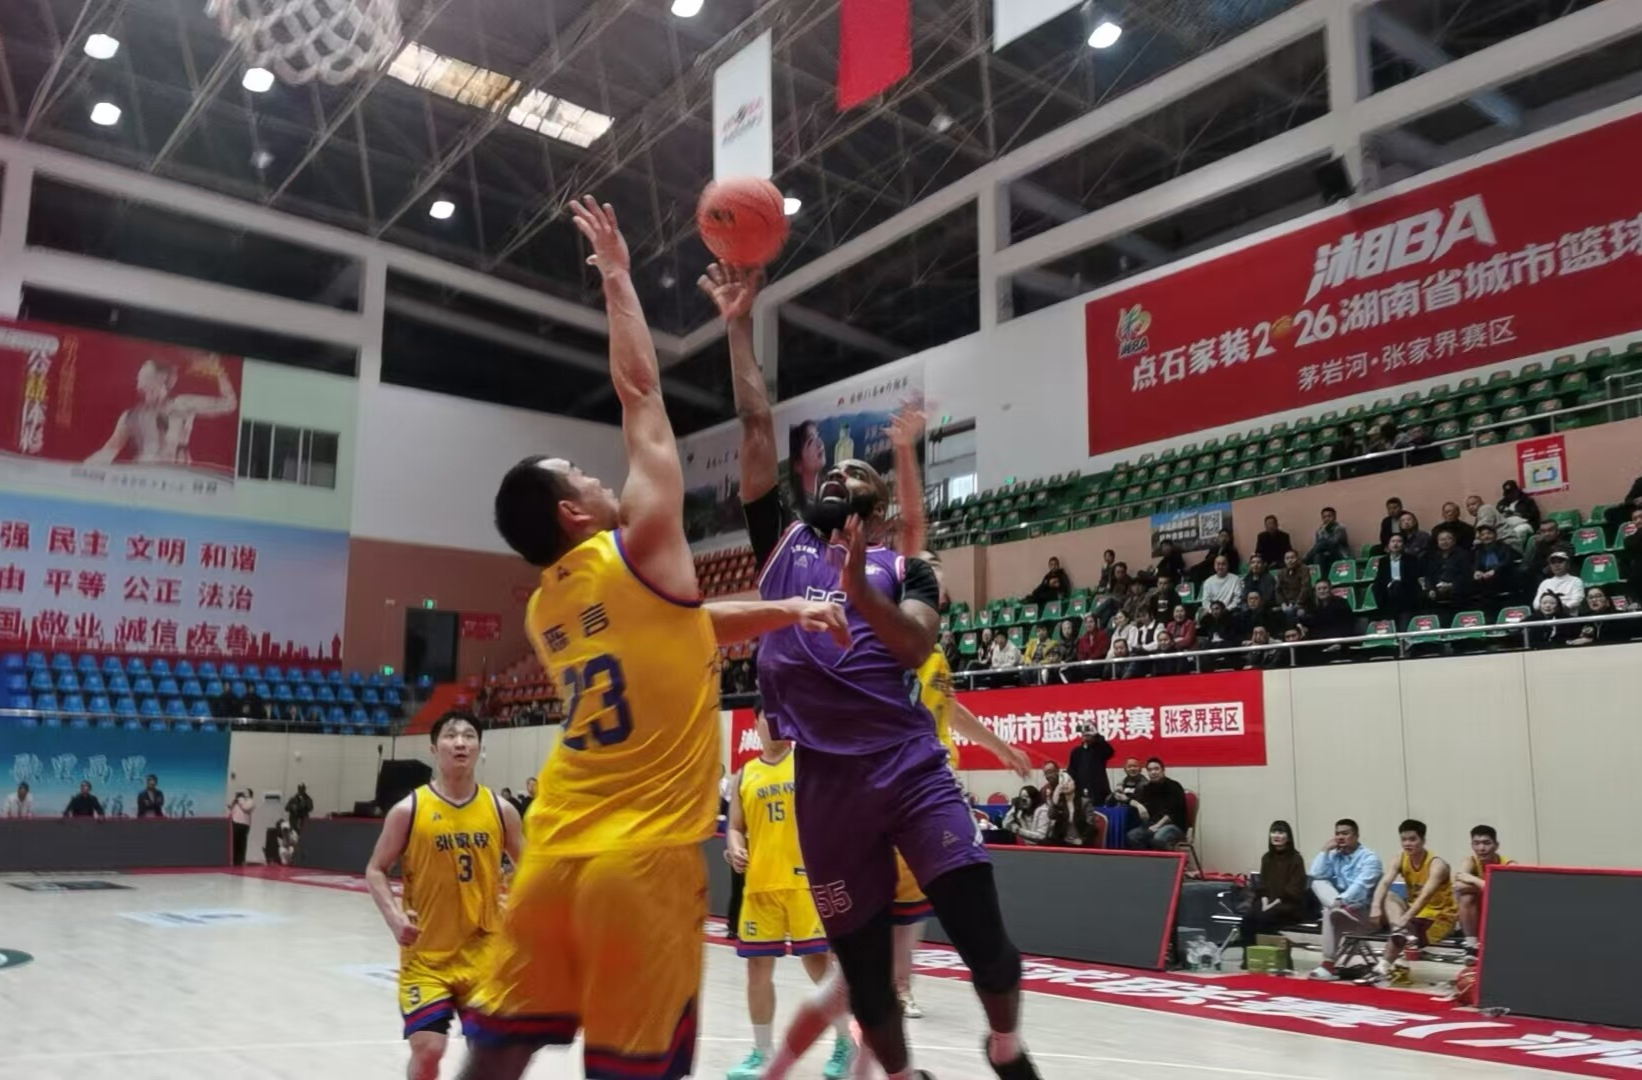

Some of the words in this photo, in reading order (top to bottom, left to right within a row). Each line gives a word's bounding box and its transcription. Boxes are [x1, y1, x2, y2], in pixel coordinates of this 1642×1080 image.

[1303, 194, 1497, 305] 湘BA
[0, 521, 29, 552] 强
[49, 526, 109, 557] 民主
[126, 535, 185, 565] 文明
[201, 542, 256, 572] 和谐
[0, 562, 25, 593] 由
[45, 568, 106, 598] 平等
[124, 575, 181, 603] 公正
[198, 582, 253, 611] 法治
[0, 607, 21, 640] 国
[38, 609, 104, 645] 敬业
[115, 616, 178, 647] 诚信
[190, 621, 250, 653] 友善
[562, 653, 634, 751] 23
[949, 707, 1155, 746] 城市篮球联赛
[1165, 707, 1239, 734] 张家界赛区
[767, 801, 785, 823] 15
[436, 832, 490, 851] 张家界
[458, 855, 473, 883] 3
[812, 880, 854, 919] 55
[745, 921, 757, 937] 15
[409, 986, 421, 1004] 3
